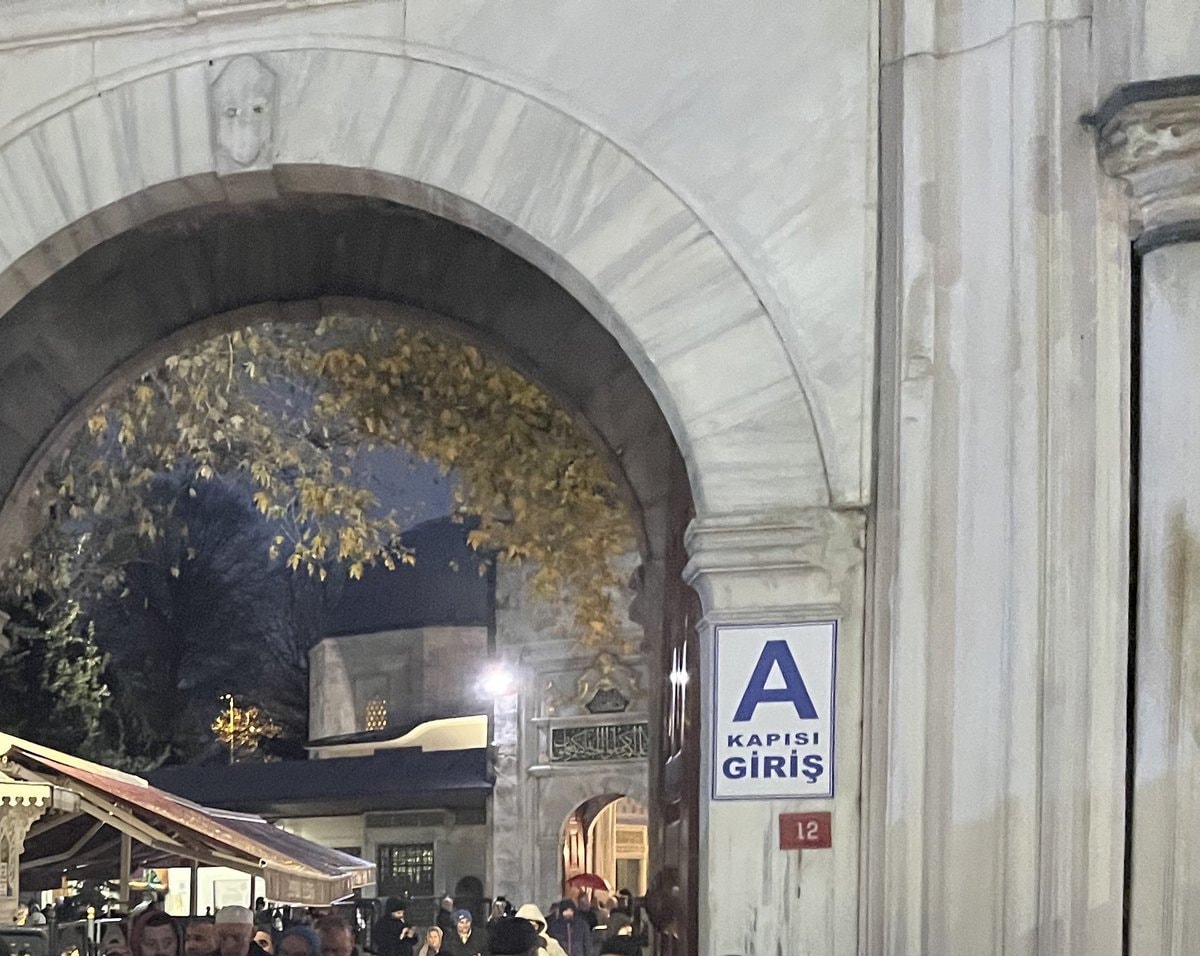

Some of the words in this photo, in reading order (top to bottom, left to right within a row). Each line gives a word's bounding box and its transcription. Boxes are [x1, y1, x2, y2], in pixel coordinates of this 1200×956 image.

[732, 640, 819, 722] A
[727, 732, 819, 747] KAPISI
[722, 749, 824, 784] GİRİŞ
[797, 821, 819, 840] 12
